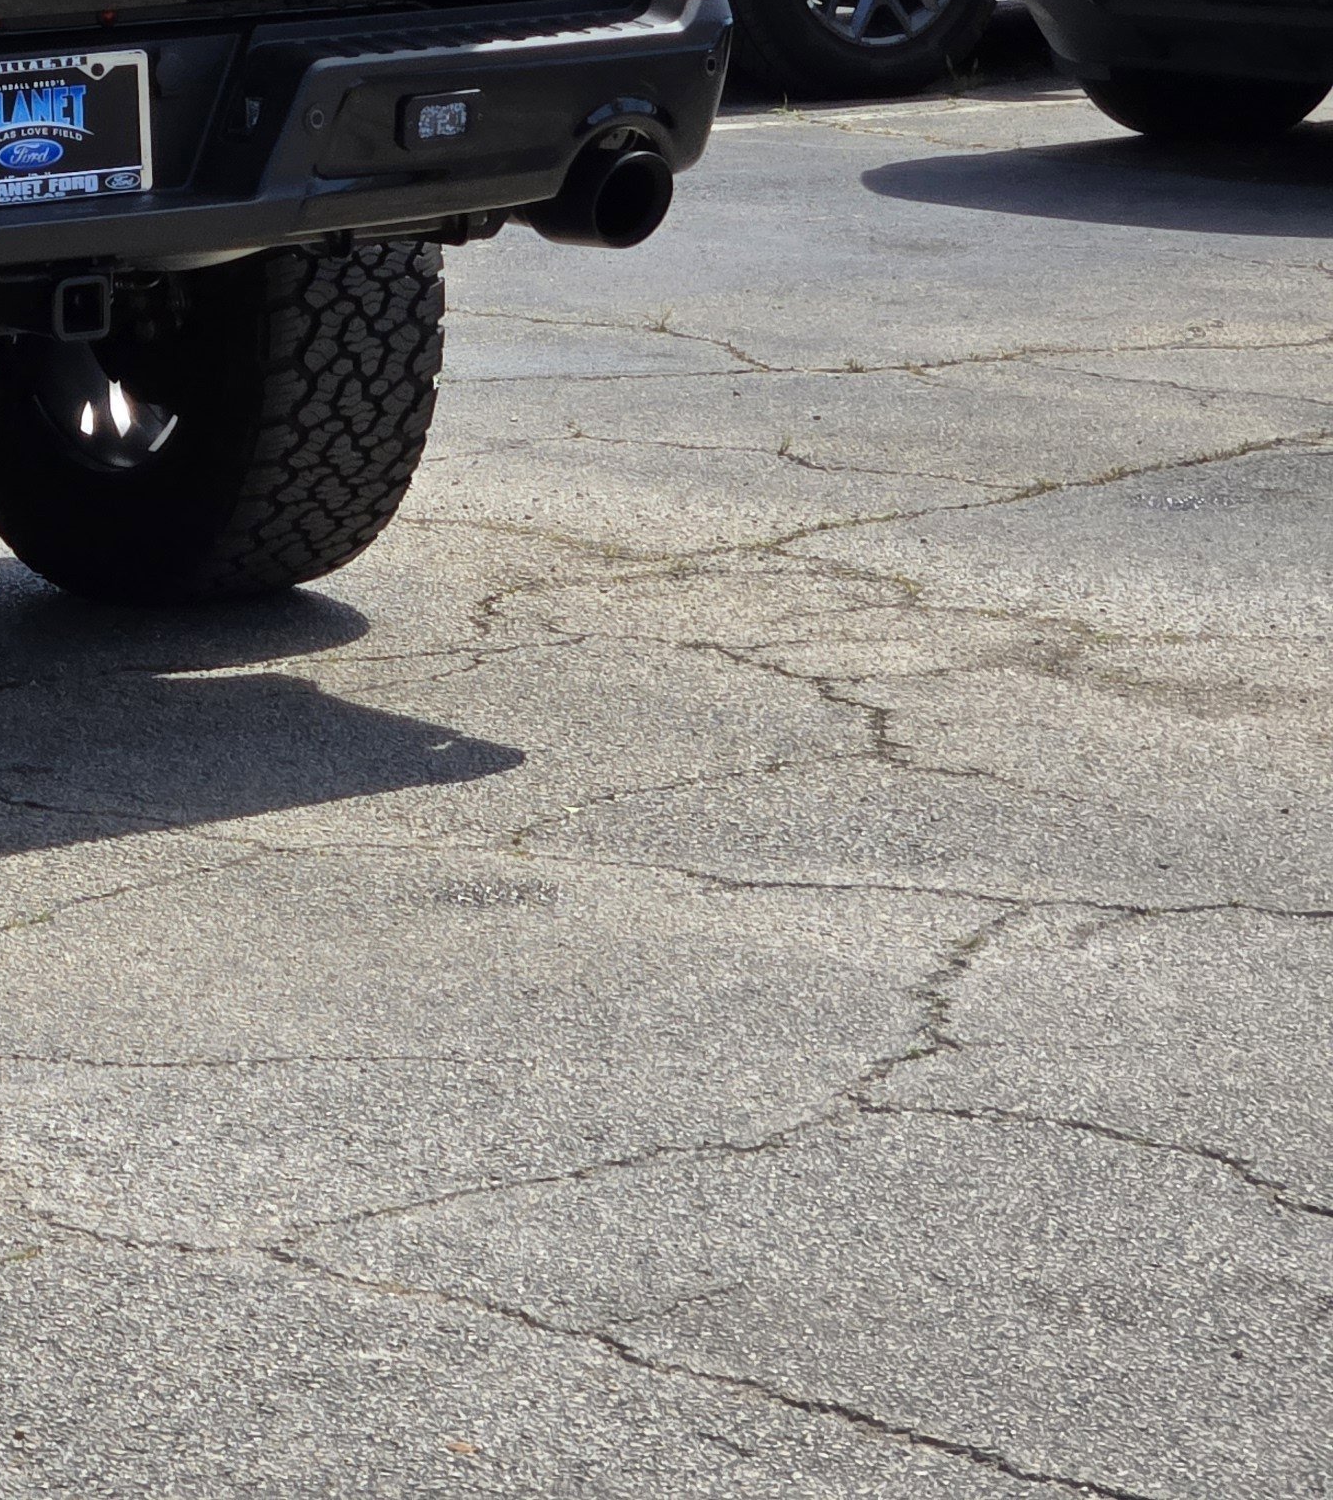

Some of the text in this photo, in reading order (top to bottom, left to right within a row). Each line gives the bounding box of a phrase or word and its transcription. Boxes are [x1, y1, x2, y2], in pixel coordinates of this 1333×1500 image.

[21, 127, 49, 137] LOVE
[52, 127, 83, 142] FIELD
[48, 174, 99, 194] FORD
